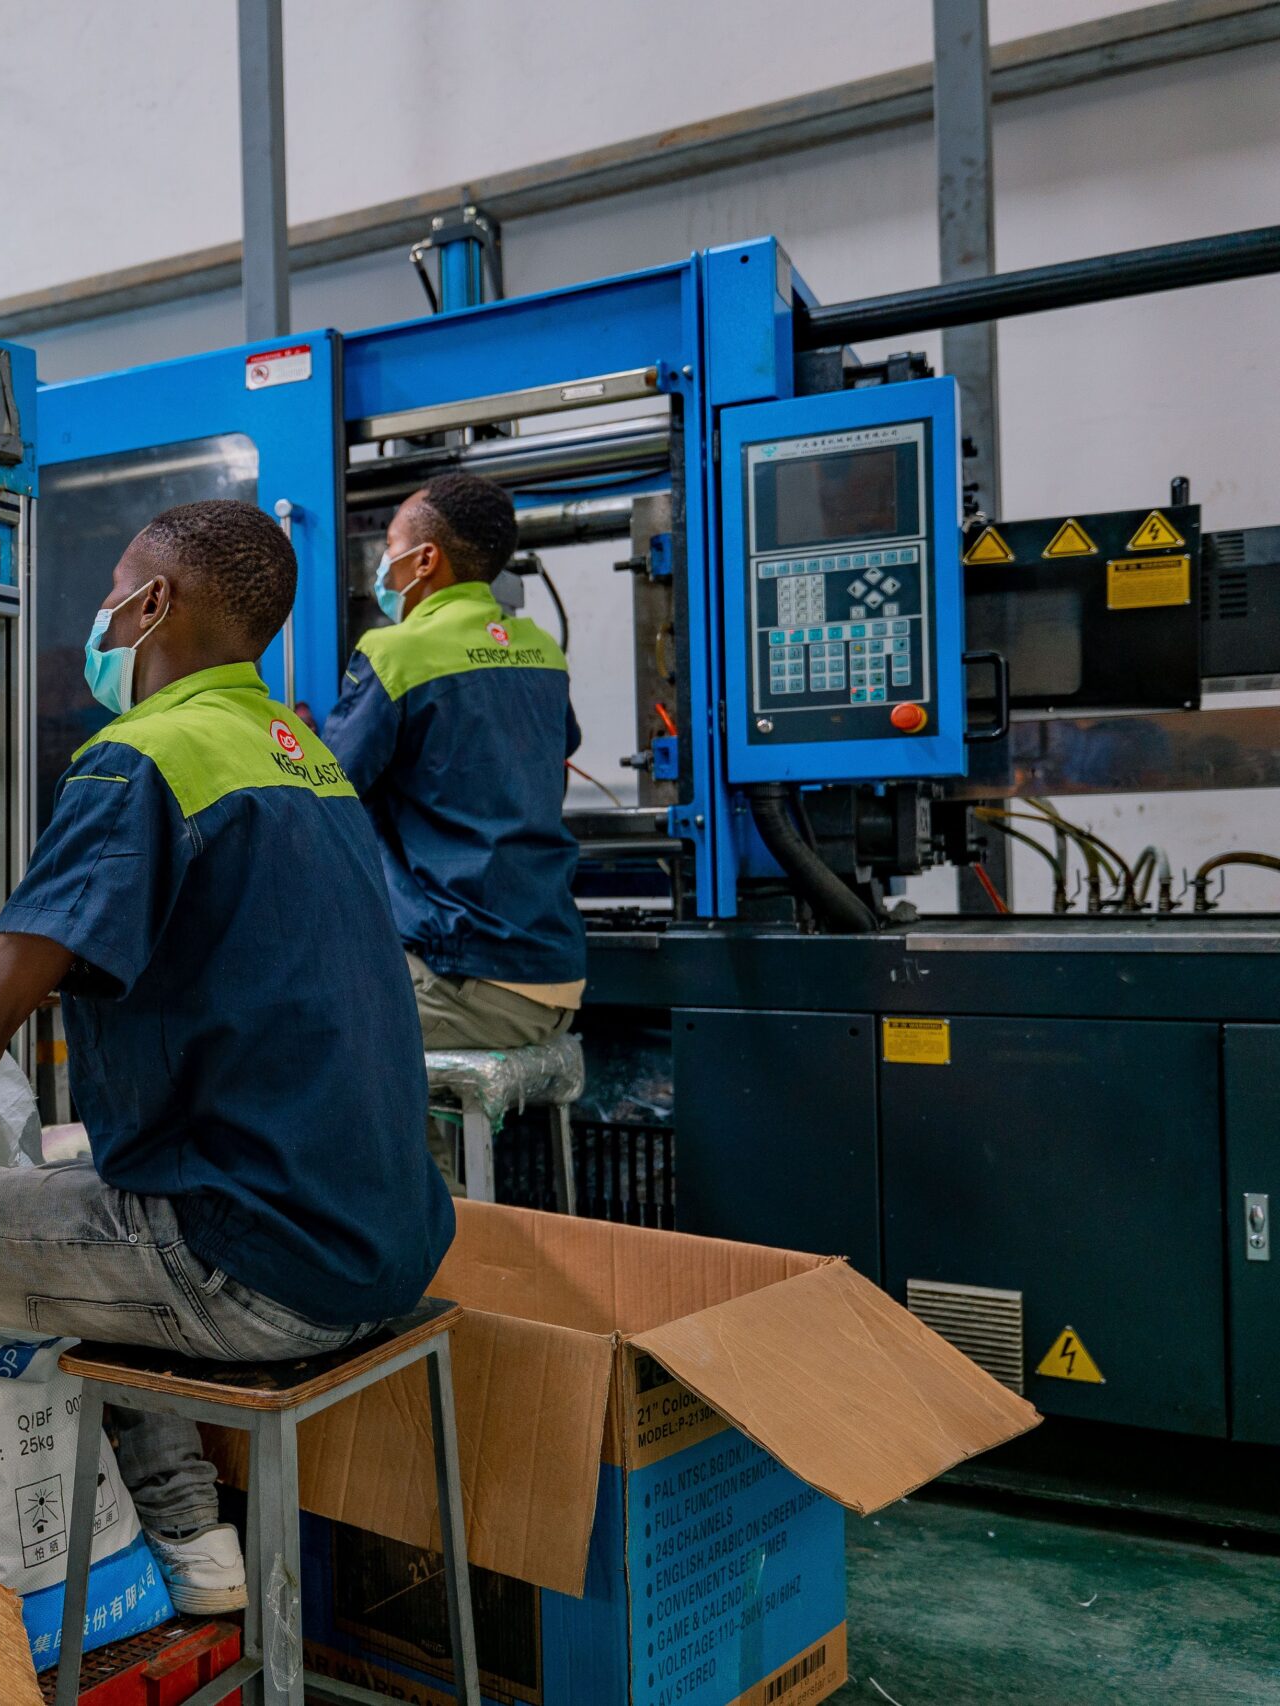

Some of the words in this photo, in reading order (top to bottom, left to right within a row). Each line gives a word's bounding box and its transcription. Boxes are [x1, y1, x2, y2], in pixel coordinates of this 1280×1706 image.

[466, 647, 545, 665] KENSPLASTIC
[20, 1434, 55, 1456] 25kg
[655, 1503, 682, 1533] FULL
[684, 1478, 738, 1518] FUNCTION
[745, 1523, 760, 1548] ON
[761, 1498, 797, 1533] SCREEN
[656, 1537, 674, 1563] 249
[677, 1505, 733, 1551] CHANNELS
[657, 1566, 726, 1621] CONVENIENT
[658, 1617, 690, 1651] GAME
[692, 1611, 700, 1631] &
[702, 1578, 754, 1625] CALENDAR
[676, 1658, 716, 1701] STEREO
